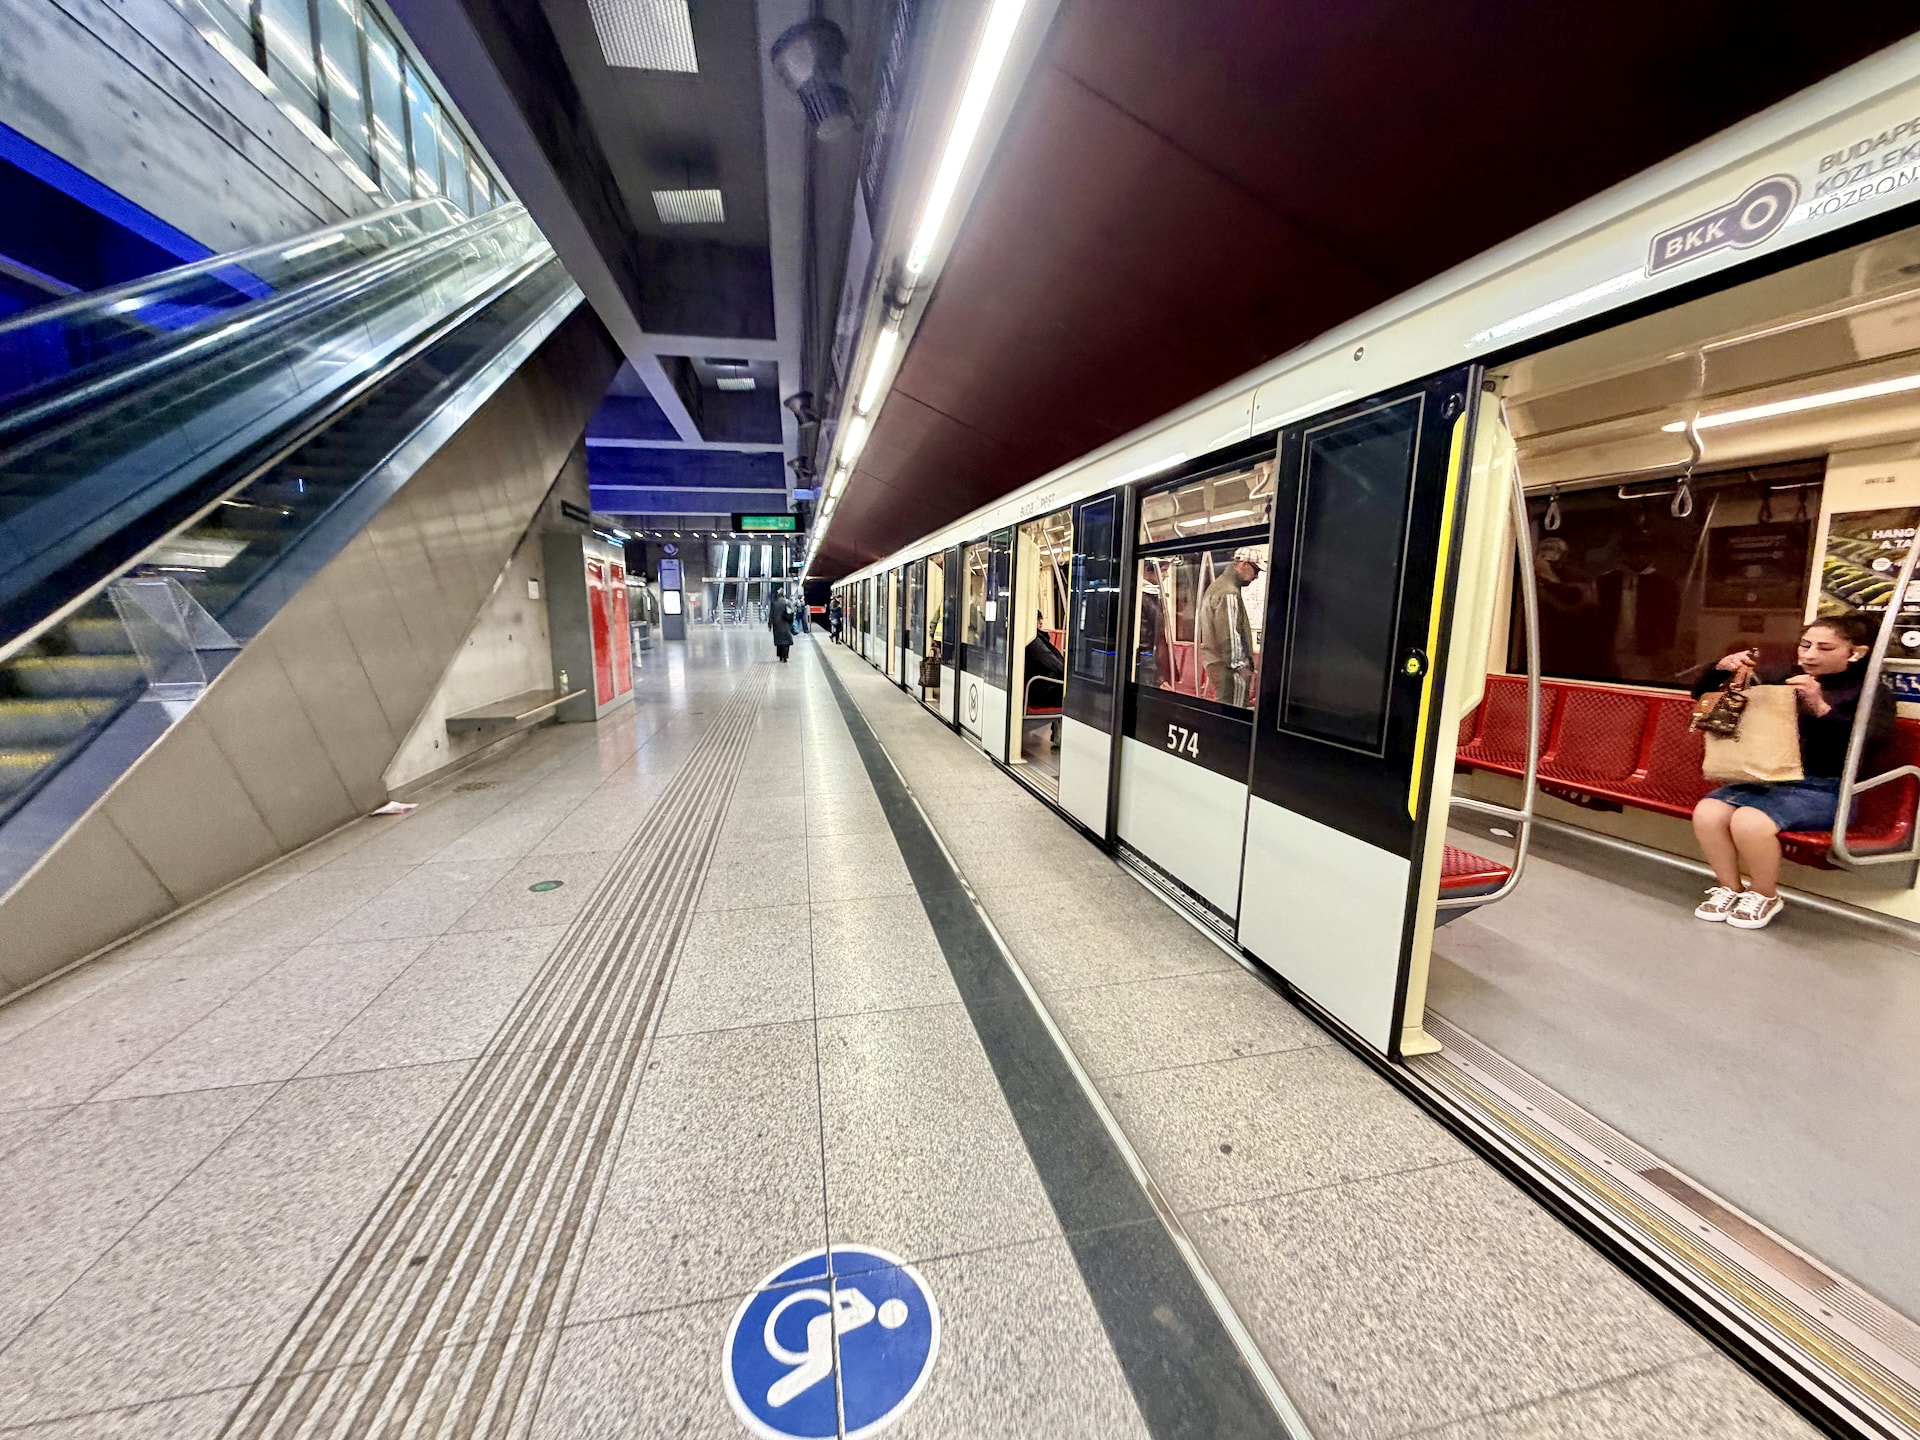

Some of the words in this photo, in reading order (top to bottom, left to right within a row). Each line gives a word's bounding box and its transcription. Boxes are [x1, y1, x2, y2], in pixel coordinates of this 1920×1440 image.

[1807, 166, 1920, 220] KÖZPON
[1664, 217, 1727, 259] BKK
[1167, 723, 1199, 759] 574
